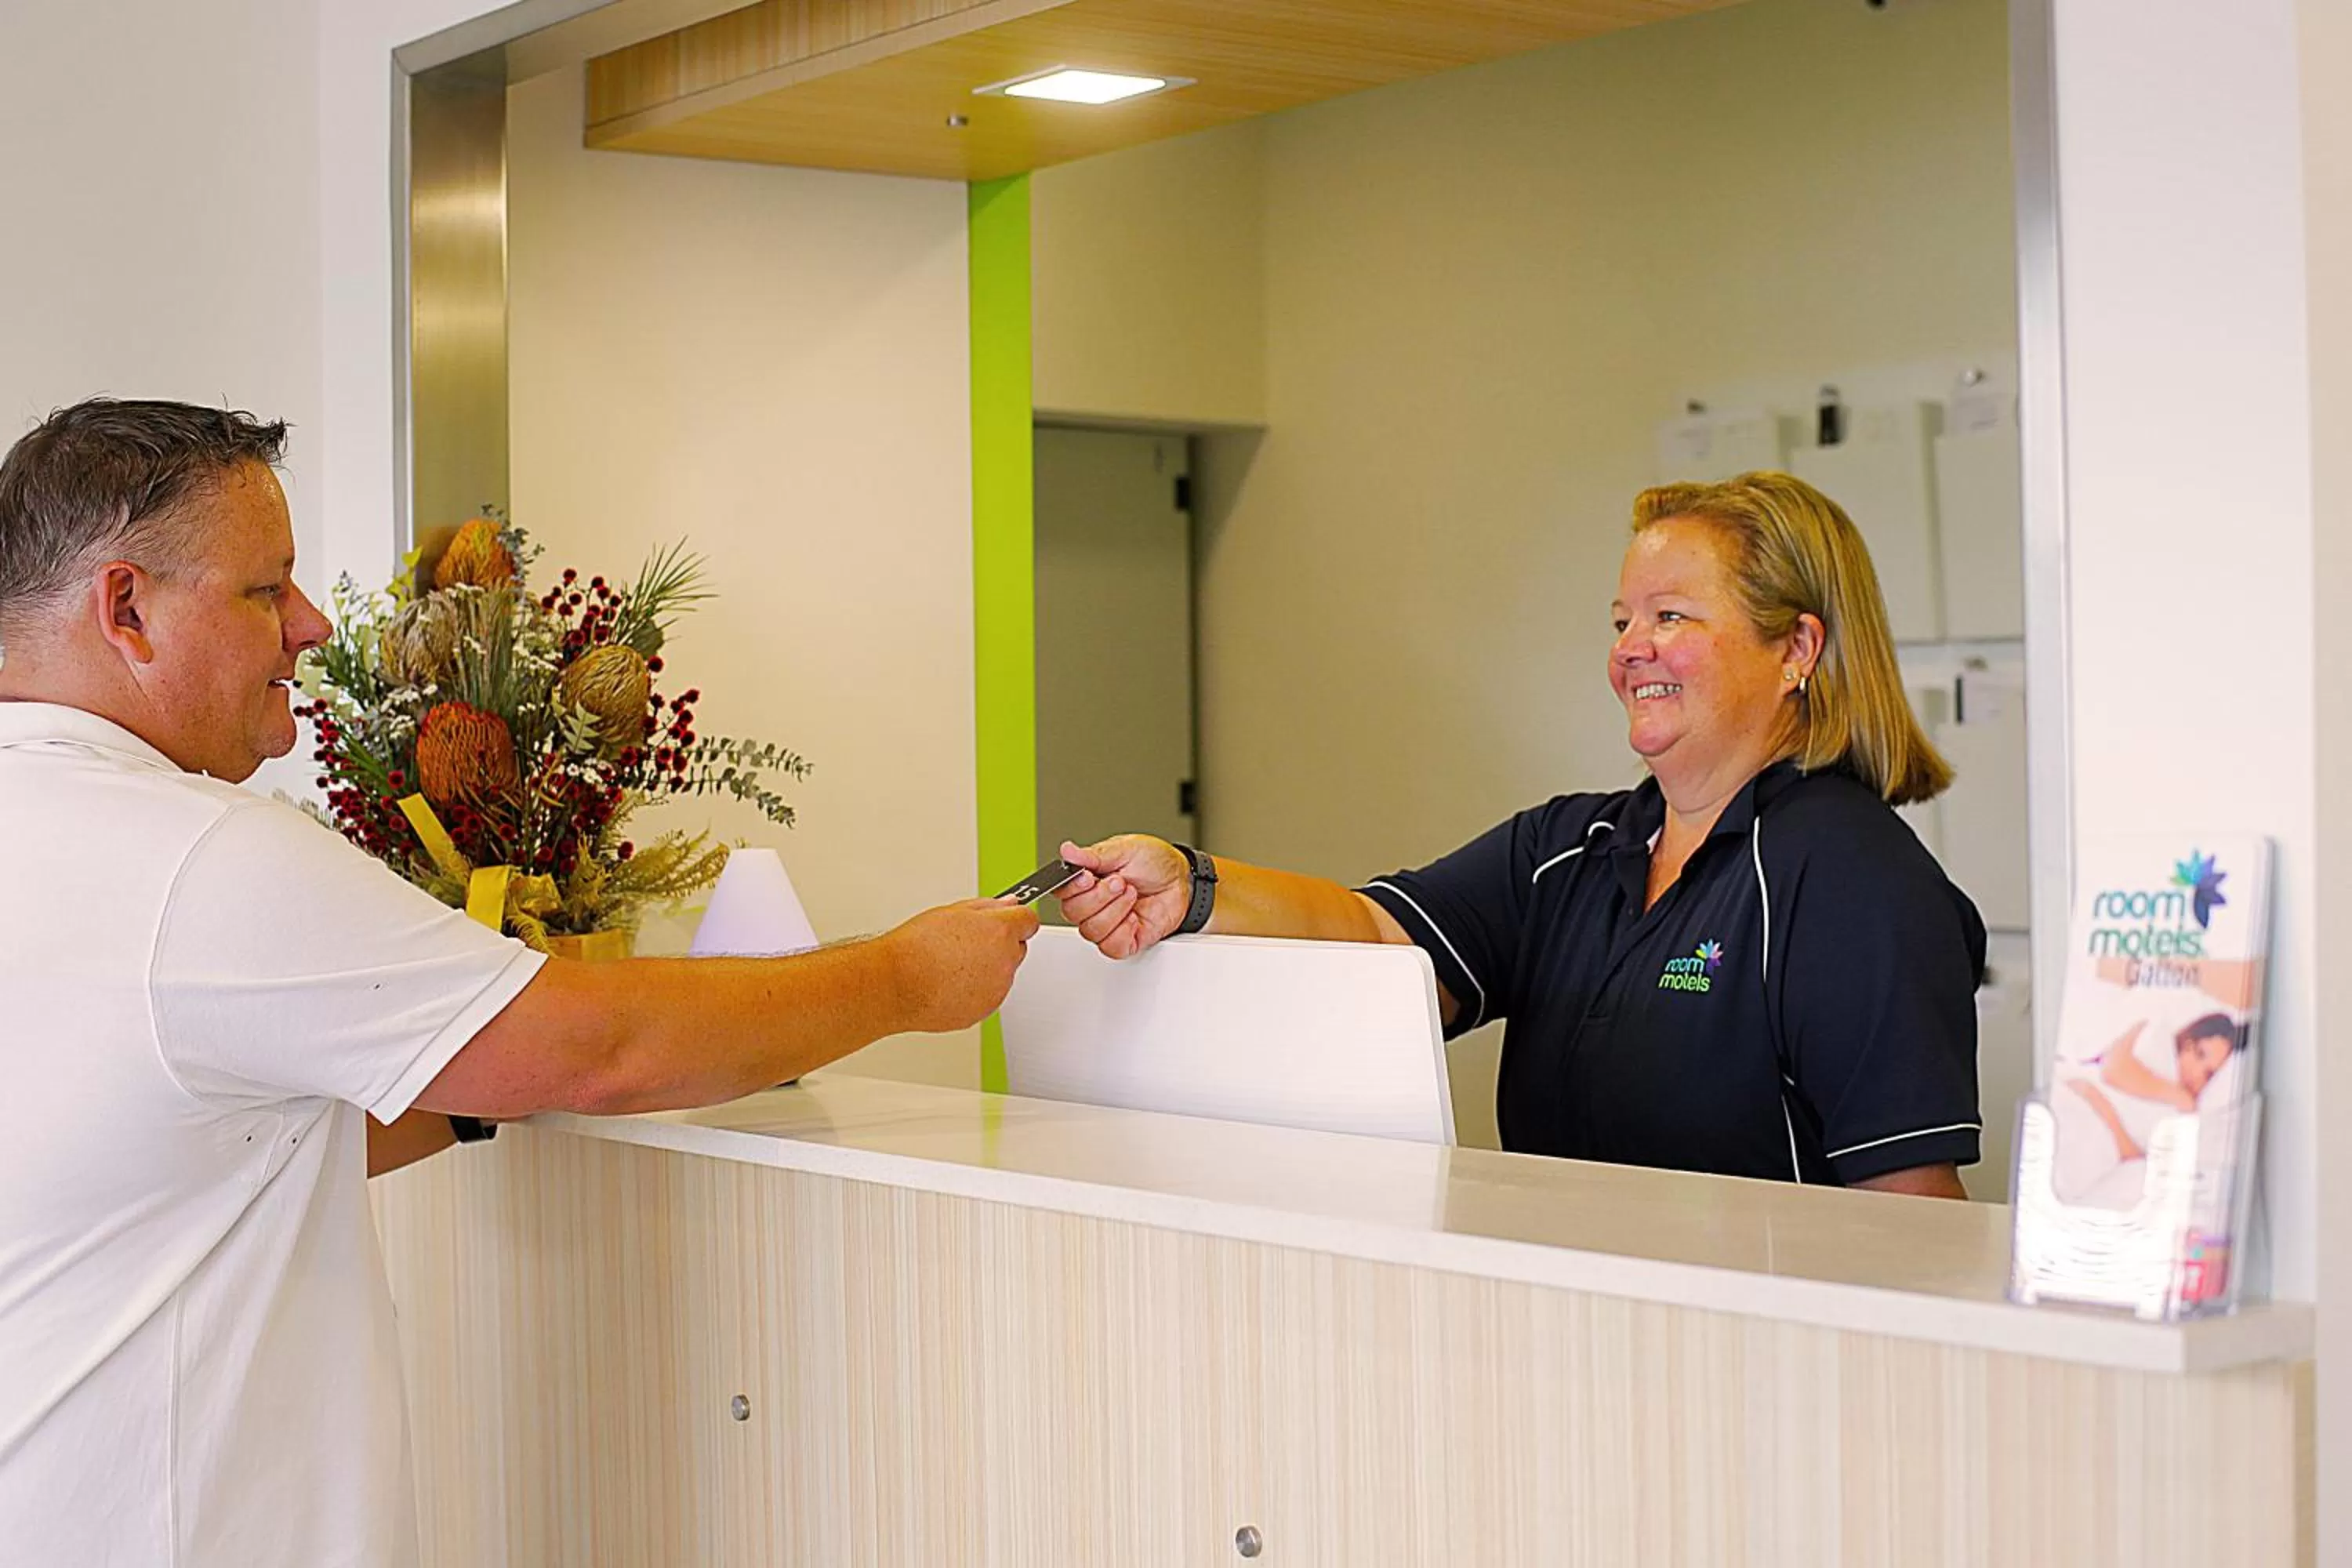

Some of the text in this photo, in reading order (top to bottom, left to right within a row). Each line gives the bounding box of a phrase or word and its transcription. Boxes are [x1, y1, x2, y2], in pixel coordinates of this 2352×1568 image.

[2092, 890, 2185, 920] room
[2088, 924, 2205, 956] motels
[1664, 957, 1705, 973] room
[1658, 972, 1711, 992] motels
